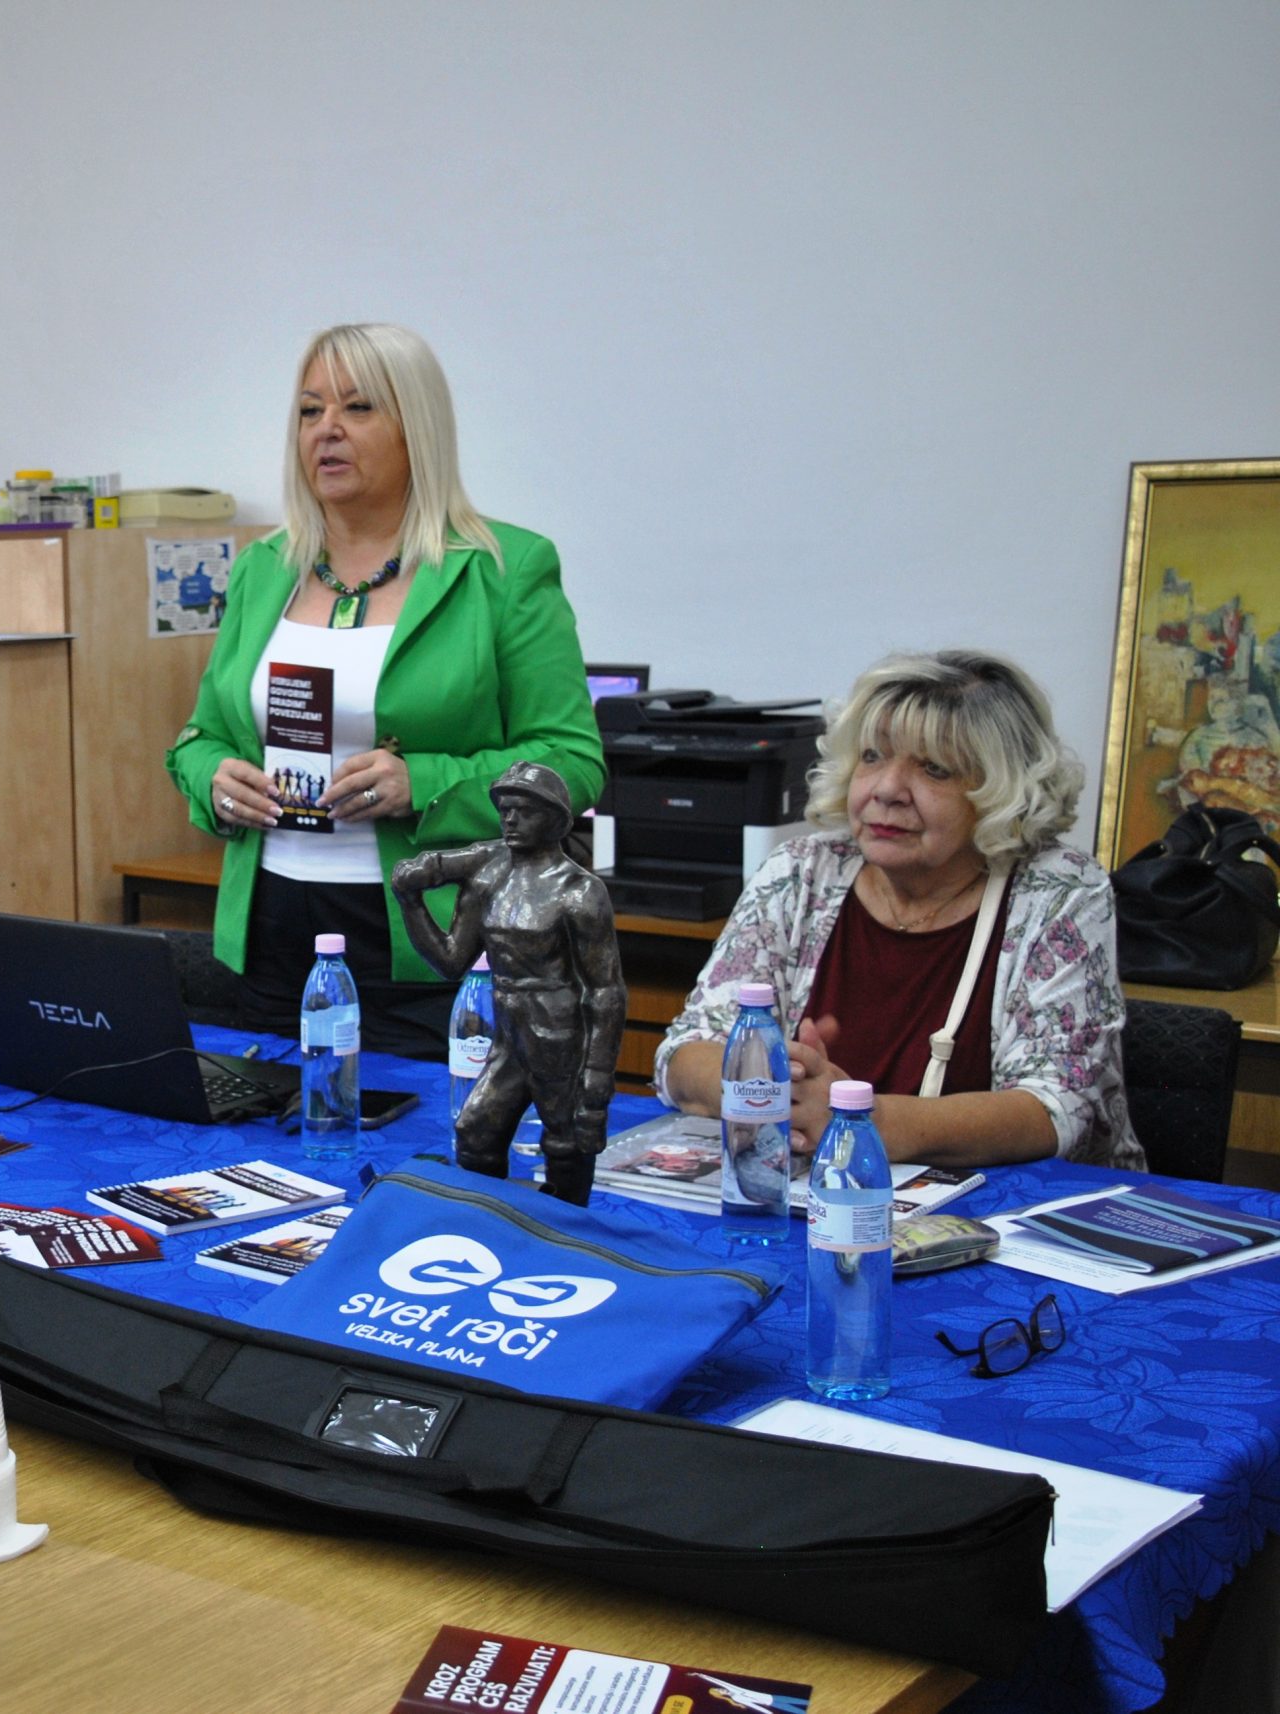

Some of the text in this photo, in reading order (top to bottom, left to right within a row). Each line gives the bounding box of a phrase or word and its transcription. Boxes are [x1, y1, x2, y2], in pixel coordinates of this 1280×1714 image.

[28, 1000, 112, 1030] TESLA
[338, 1292, 453, 1333] svet
[344, 1322, 486, 1368] VELIKA PLANA
[424, 1662, 462, 1699] KROZ
[450, 1640, 503, 1703] PROGRAM
[503, 1645, 557, 1713] RAZVIJATI:
